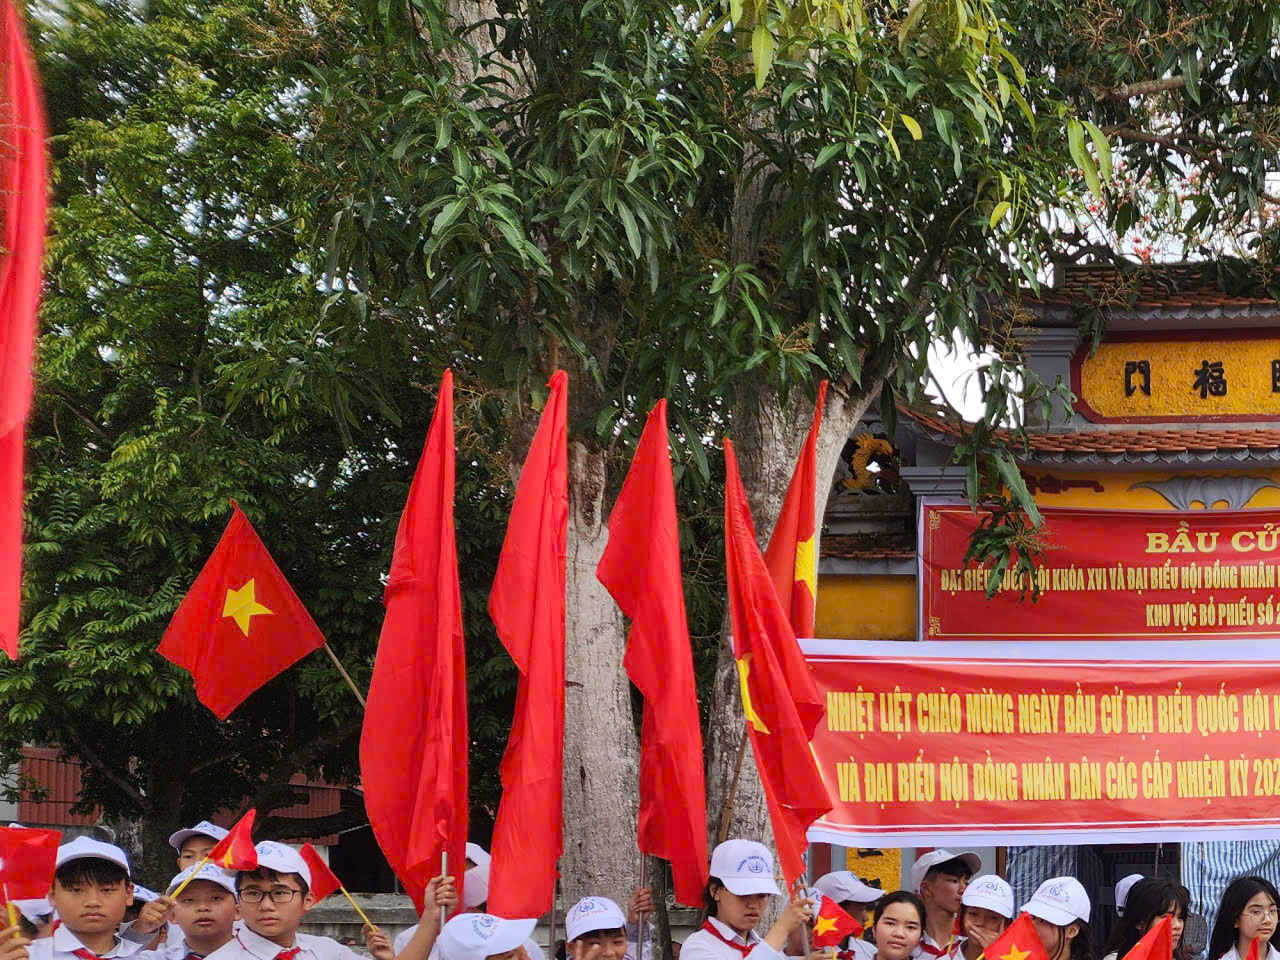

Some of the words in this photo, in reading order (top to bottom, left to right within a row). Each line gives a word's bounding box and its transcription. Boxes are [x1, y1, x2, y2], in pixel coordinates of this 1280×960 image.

[1145, 520, 1220, 553] BẦU
[941, 568, 962, 596] ĐẠI
[1052, 563, 1085, 591] KHÓA
[1087, 567, 1107, 591] XVI
[1108, 562, 1126, 591] VÀ
[1126, 567, 1148, 595] ĐẠI
[1150, 558, 1179, 590] BIỂU
[1181, 561, 1202, 594] HỘI
[1204, 559, 1238, 589] ĐỒNG
[1240, 560, 1275, 588] NHÂN
[1146, 604, 1171, 627] KHU
[1172, 601, 1197, 632] VỰC
[1199, 595, 1216, 626] BỎ
[1218, 595, 1255, 626] PHIẾU
[1257, 594, 1274, 625] SỐ
[826, 685, 875, 740] NHIỆT
[879, 685, 913, 740] LIỆT
[916, 686, 962, 734] CHÀO
[965, 687, 1015, 734] MỪNG
[1018, 688, 1060, 734] NGÀY
[1063, 681, 1097, 734] BẦU
[1100, 686, 1124, 734] CỬ
[1126, 695, 1154, 741] ĐẠI
[1158, 681, 1193, 735] BIỂU
[1196, 681, 1239, 737] QUỐC
[1242, 687, 1270, 738] HỘI
[836, 755, 861, 803] VÀ
[863, 762, 894, 810] ĐẠI
[897, 748, 936, 803] BIỂU
[939, 755, 969, 809] HỘI
[972, 749, 1018, 801] ĐỒNG
[1021, 755, 1066, 801] NHÂN
[1069, 755, 1102, 801] DÂN
[1105, 755, 1138, 800] CÁC
[1141, 749, 1173, 799] CẤP
[1176, 753, 1226, 805] NHIỆM
[1229, 753, 1249, 797] KỲ
